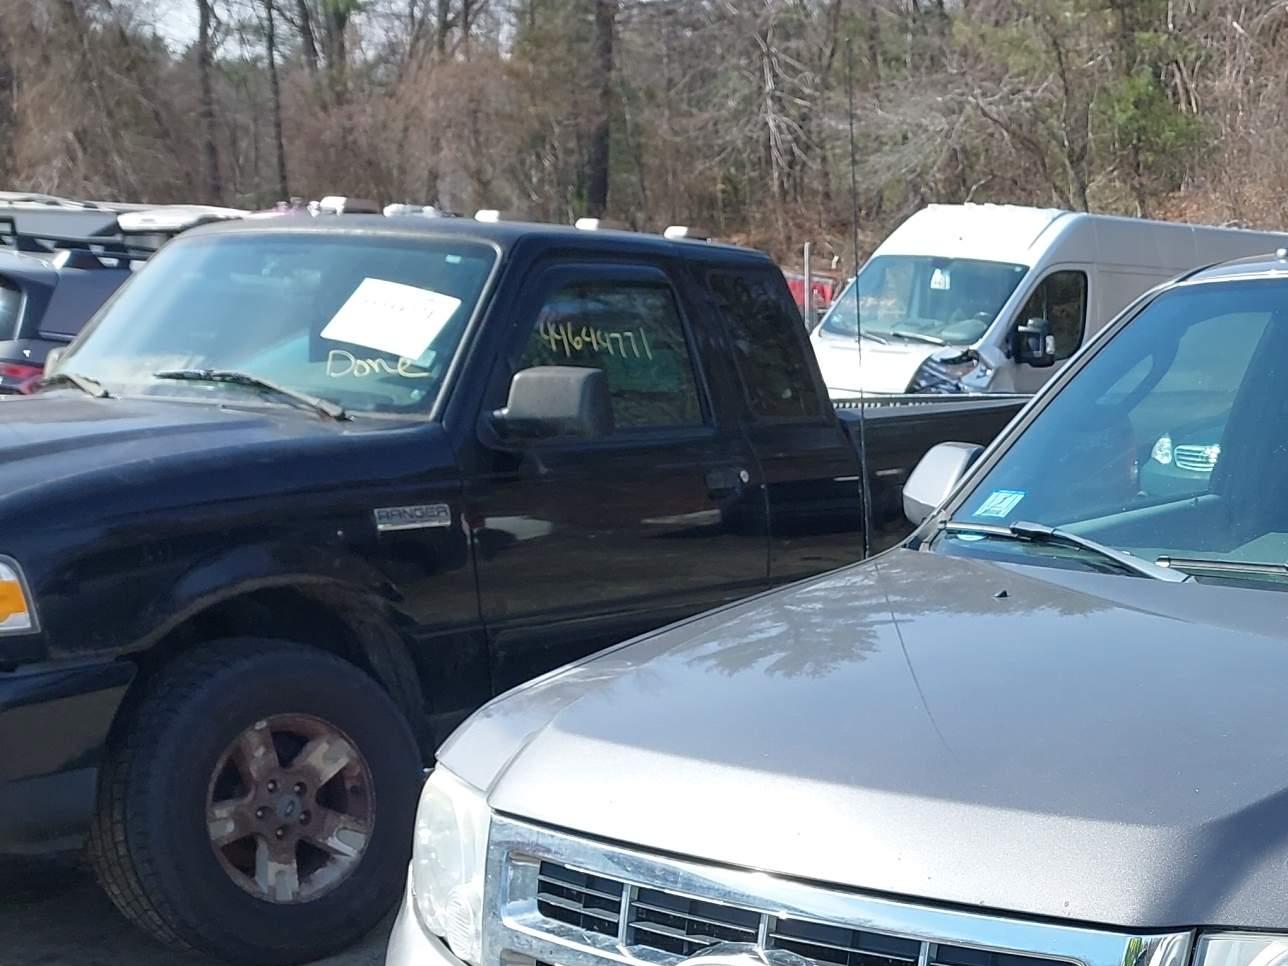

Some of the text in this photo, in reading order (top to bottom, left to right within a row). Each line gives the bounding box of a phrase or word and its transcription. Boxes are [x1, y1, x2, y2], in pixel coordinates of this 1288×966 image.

[540, 319, 653, 360] 44644771
[326, 349, 432, 378] Done
[378, 505, 448, 522] RANGER
